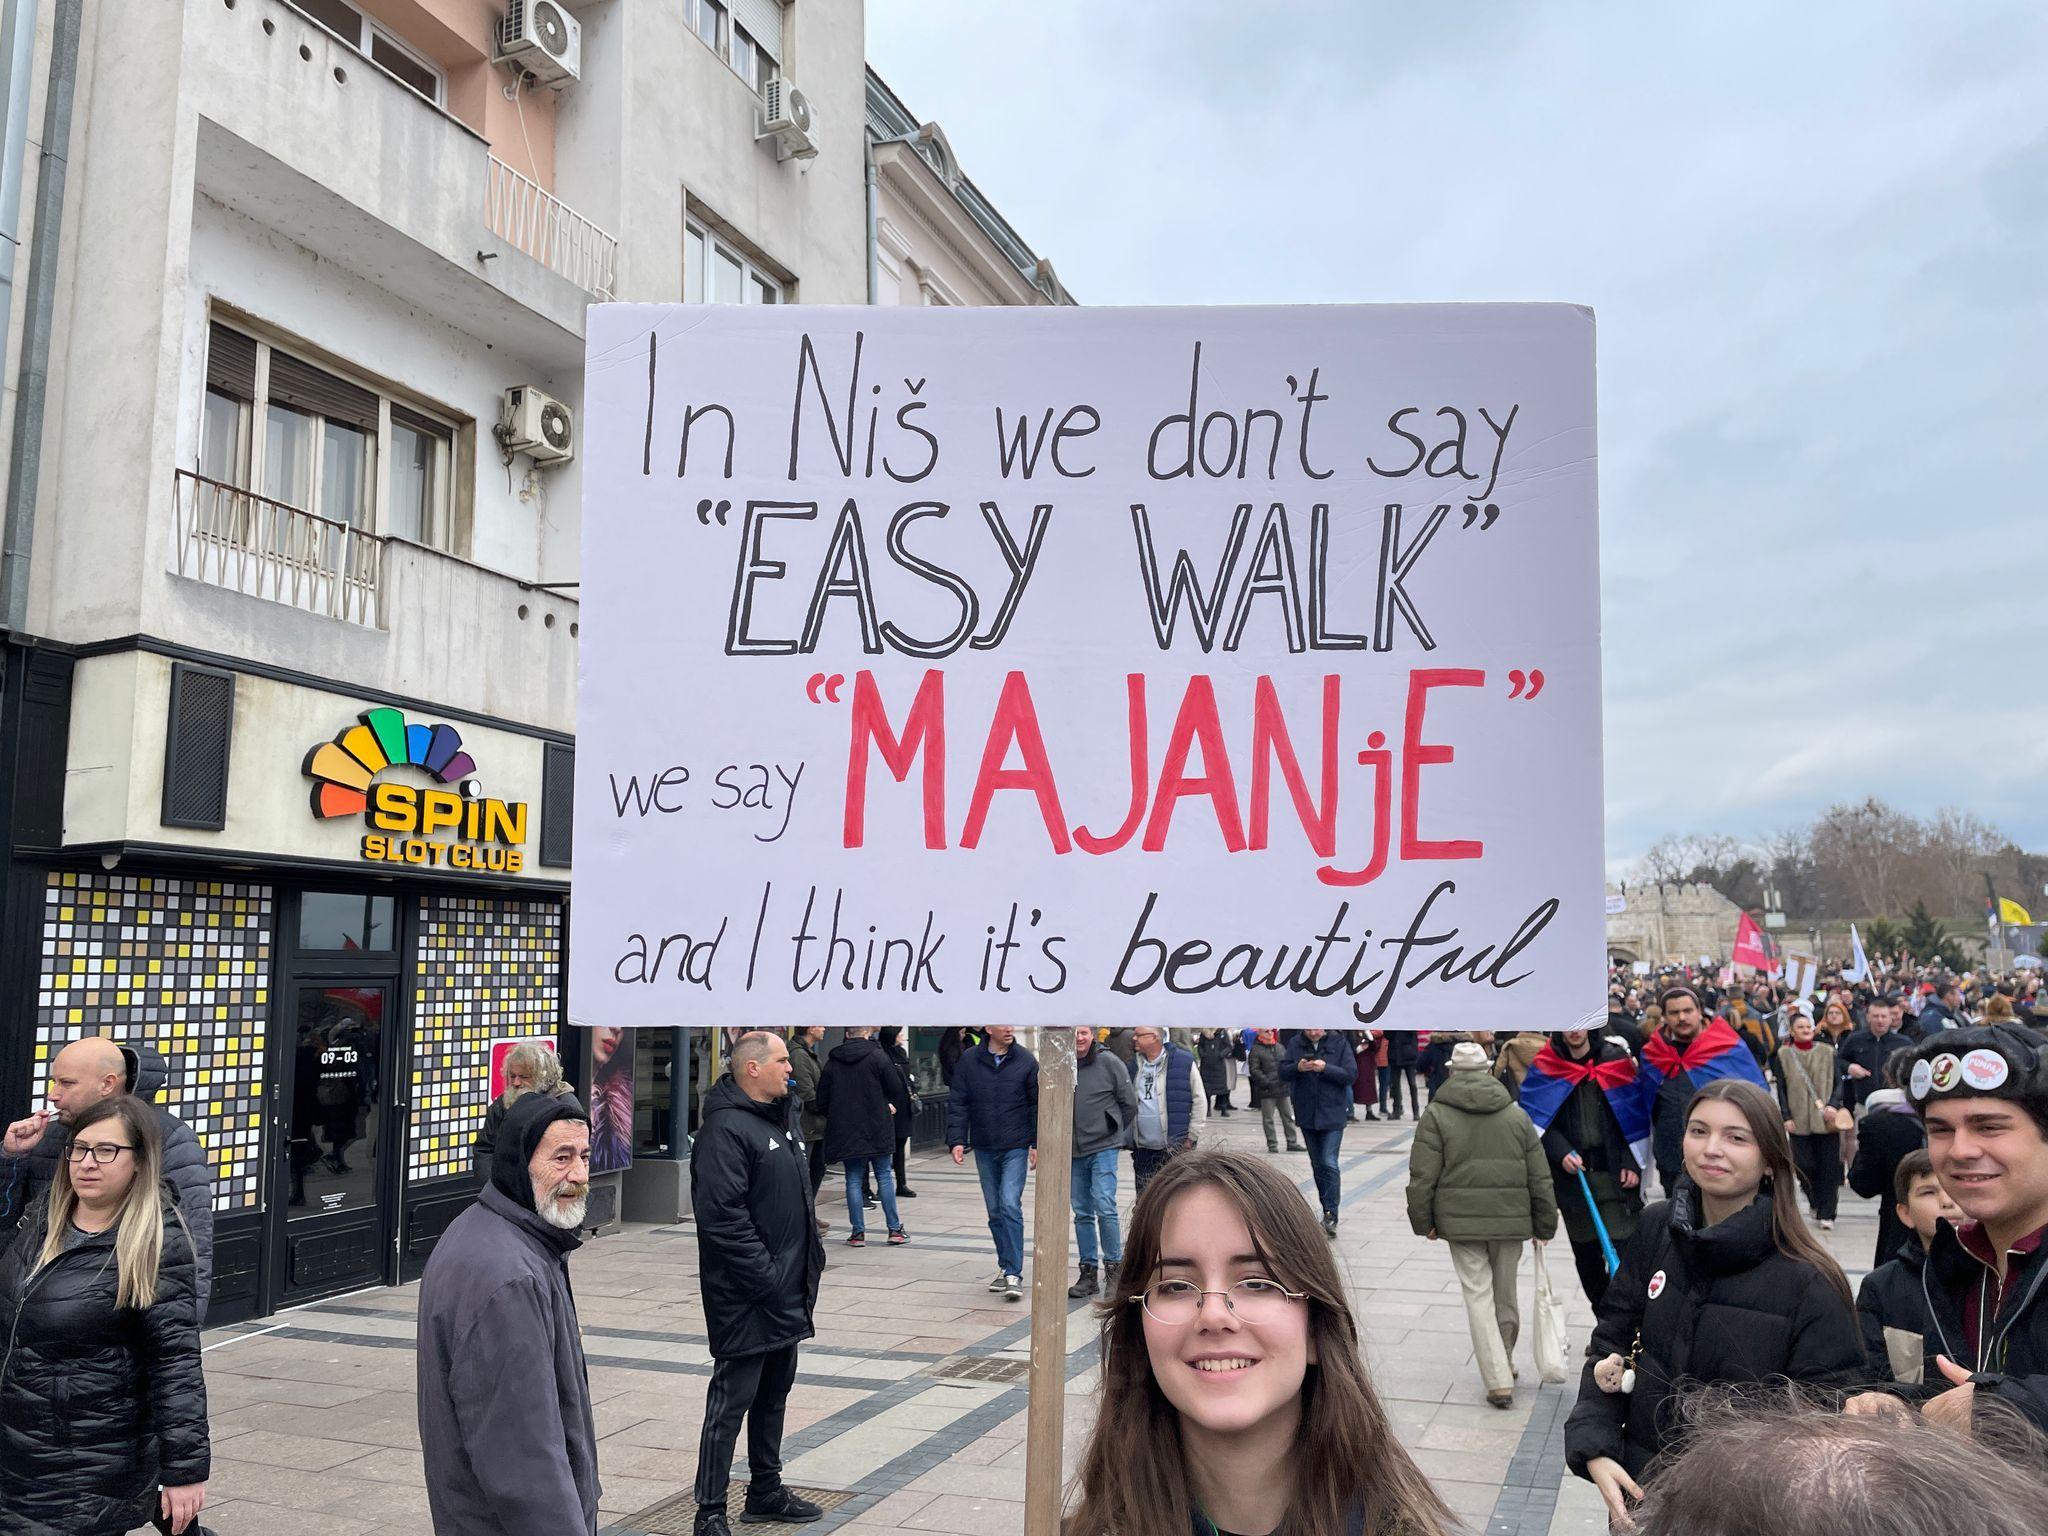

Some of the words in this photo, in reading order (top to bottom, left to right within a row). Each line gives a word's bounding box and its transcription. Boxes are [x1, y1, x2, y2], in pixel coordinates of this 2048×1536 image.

[643, 332, 734, 480] In
[787, 331, 939, 484] Niš
[995, 404, 1101, 480] we
[1147, 341, 1335, 481] don’t
[1366, 403, 1520, 502] say
[696, 498, 1054, 660] “EASY
[1129, 502, 1501, 654] WALK”
[362, 834, 447, 866] SLOT
[449, 843, 525, 873] CLUB
[609, 765, 690, 818] we
[711, 763, 805, 843] say
[614, 916, 728, 991] and
[746, 881, 771, 992] I
[792, 885, 946, 994] think
[979, 902, 1067, 994] it’s
[1110, 880, 1560, 1025] beautiful
[1144, 1083, 1154, 1100] K
